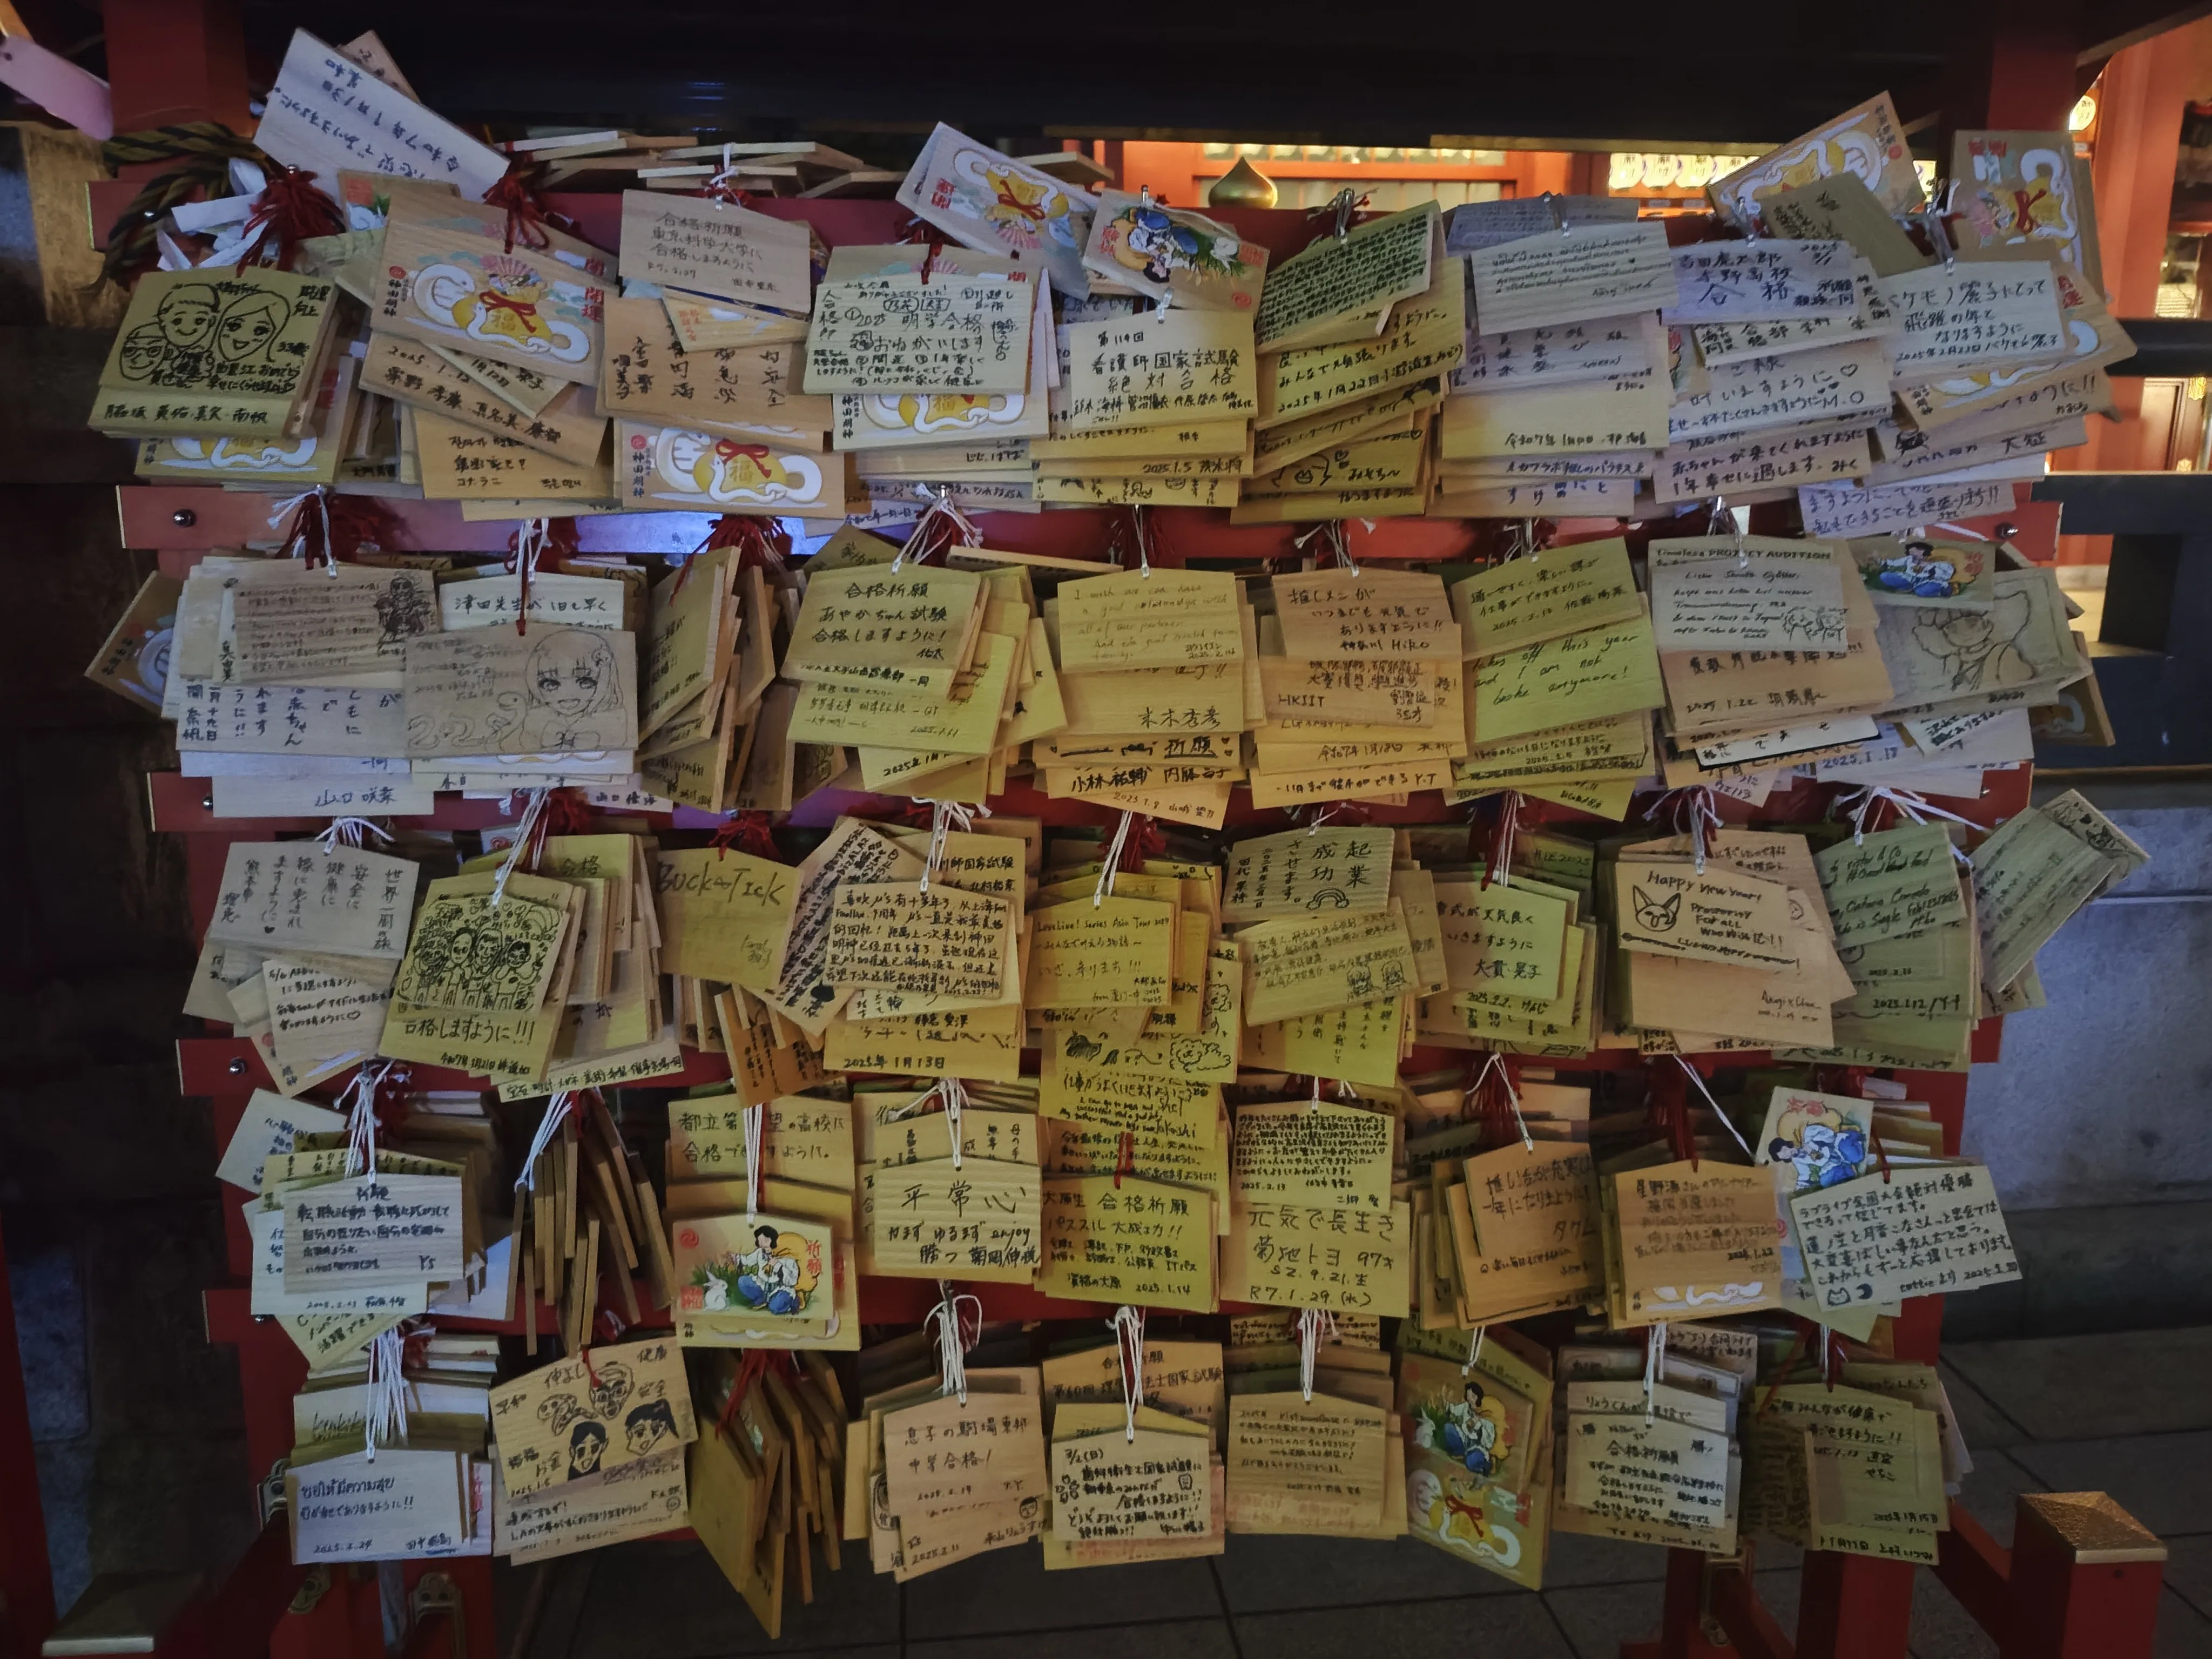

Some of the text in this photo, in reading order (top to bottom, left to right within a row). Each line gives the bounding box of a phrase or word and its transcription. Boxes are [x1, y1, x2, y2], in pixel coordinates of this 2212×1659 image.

[656, 211, 743, 236] 合格祈願
[1092, 349, 1240, 375] 看護師国家試験
[1108, 368, 1234, 394] 絶対合格
[631, 451, 646, 498] 神田明神
[846, 582, 929, 599] 合格祈願
[1310, 841, 1338, 883] 成功
[1344, 840, 1373, 888] 起業
[1647, 869, 1695, 893] Happy
[900, 1178, 1027, 1219] 平常心
[1097, 1191, 1190, 1217] 合格祈願
[990, 1220, 1031, 1252] enjoy
[1247, 1202, 1395, 1243] 元気で長生き
[806, 1239, 823, 1276] 祈願
[919, 1242, 957, 1265] 勝つ
[905, 1416, 1028, 1446] 息子の駒場東邦
